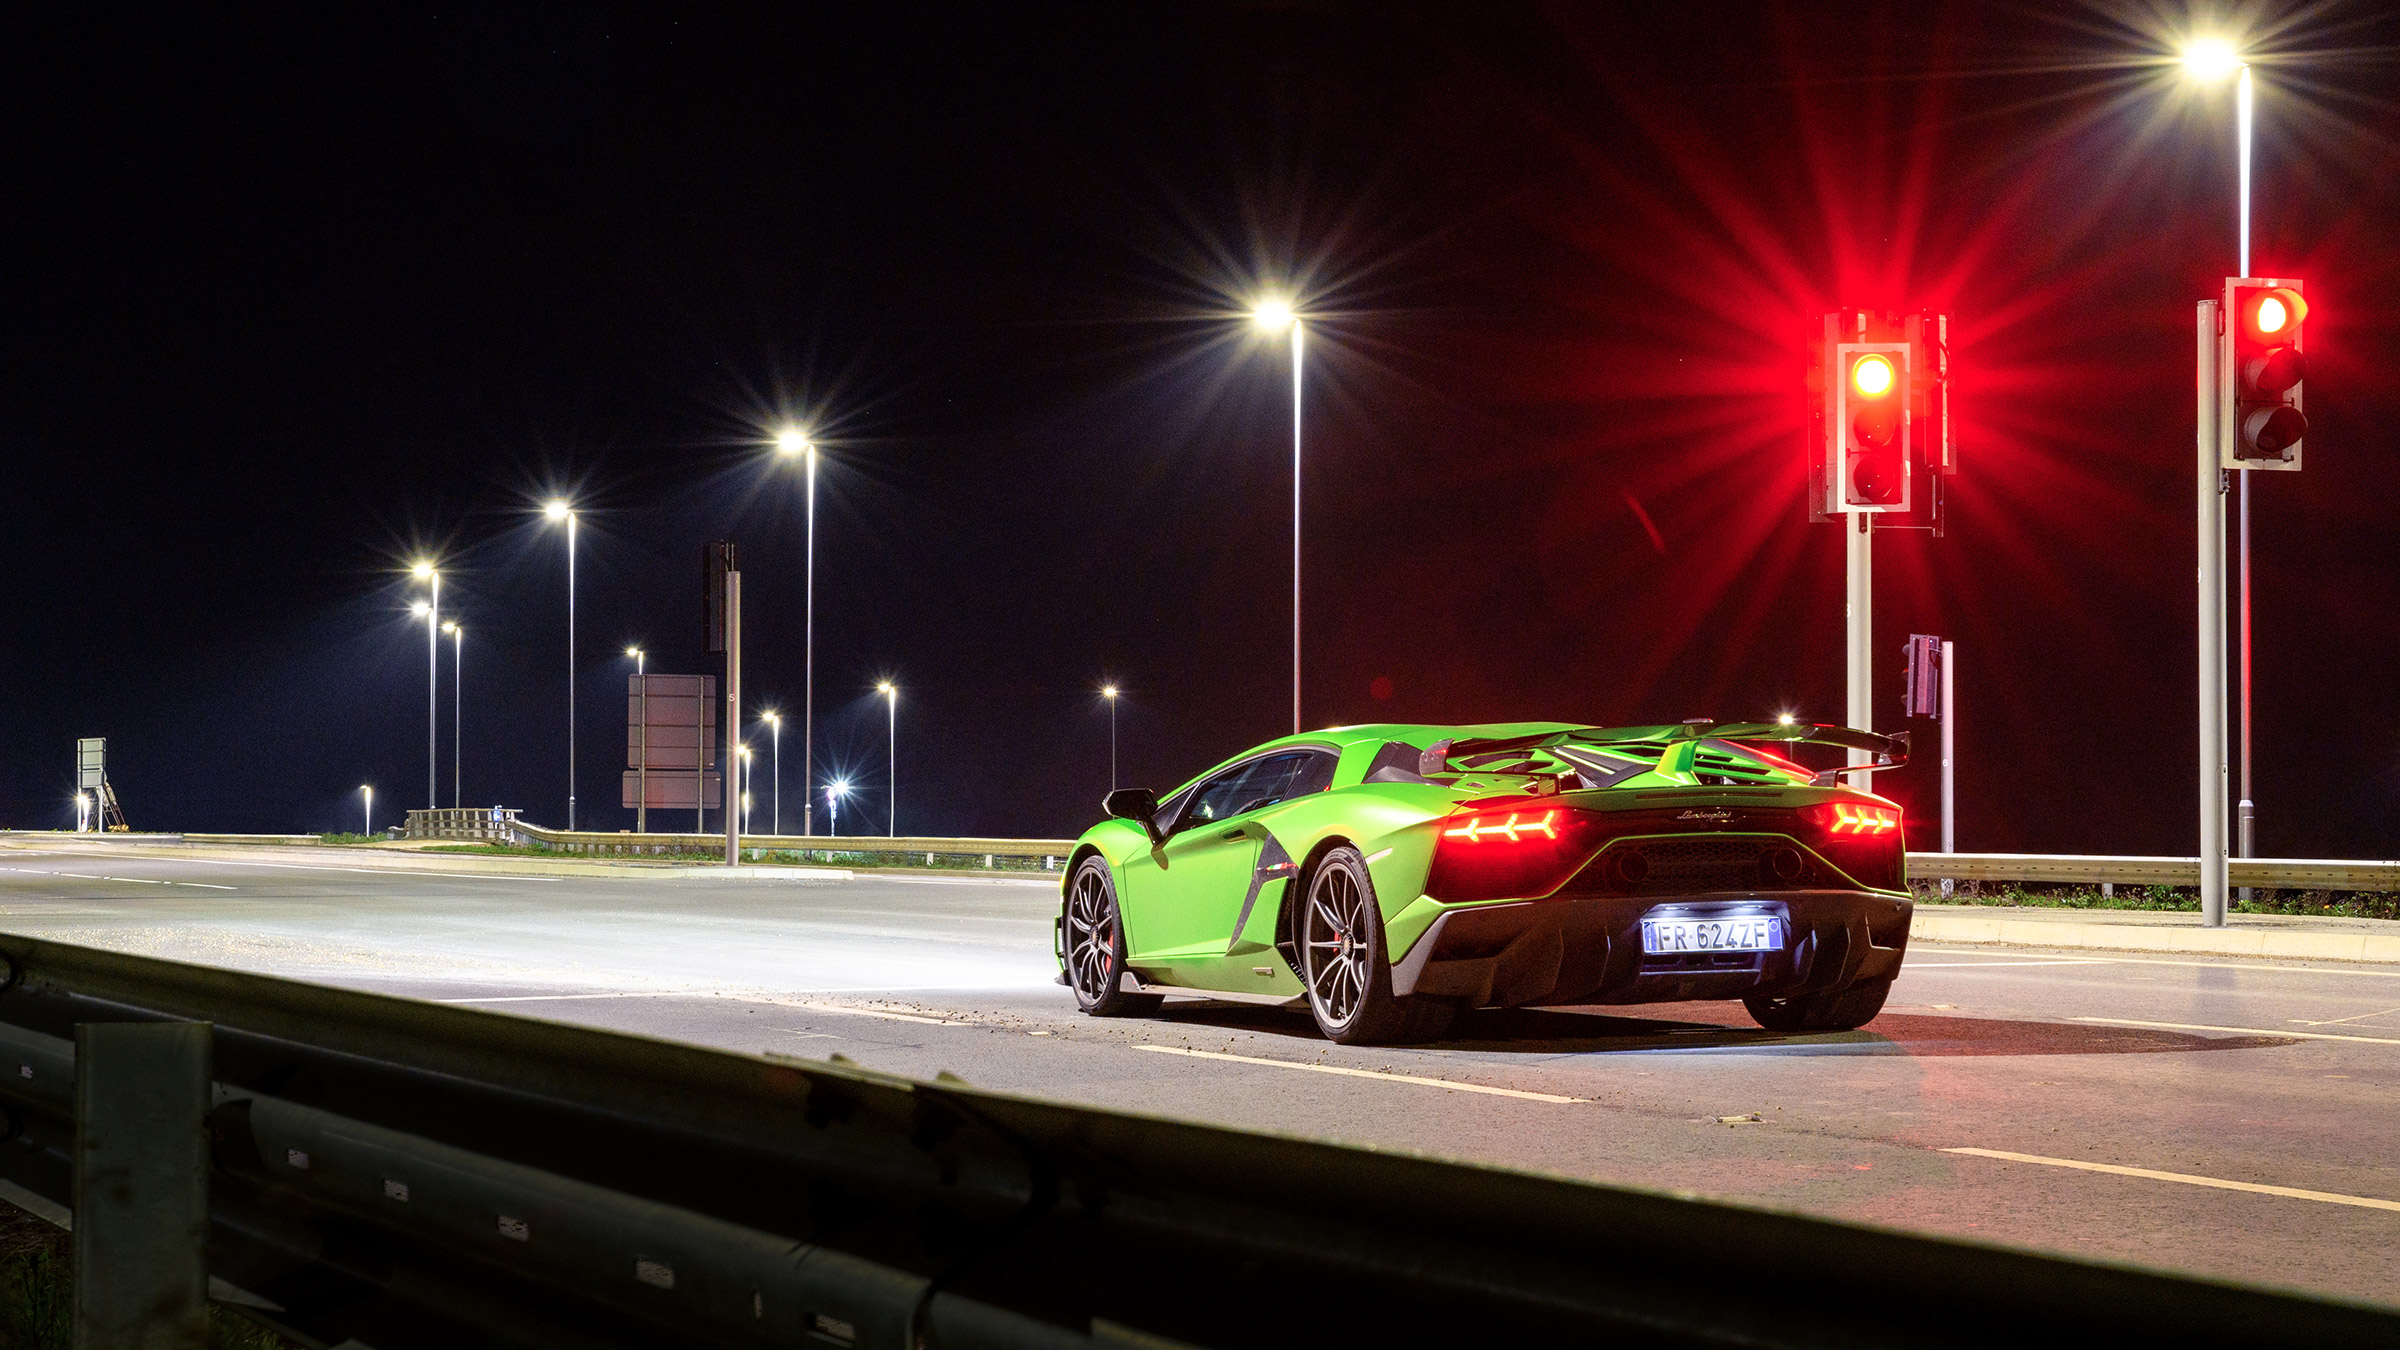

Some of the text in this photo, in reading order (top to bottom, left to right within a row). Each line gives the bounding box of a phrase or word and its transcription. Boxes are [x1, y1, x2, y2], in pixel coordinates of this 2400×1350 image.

[729, 693, 735, 702] 5
[1942, 758, 1949, 767] 6
[1658, 922, 1765, 950] FR 624ZF
